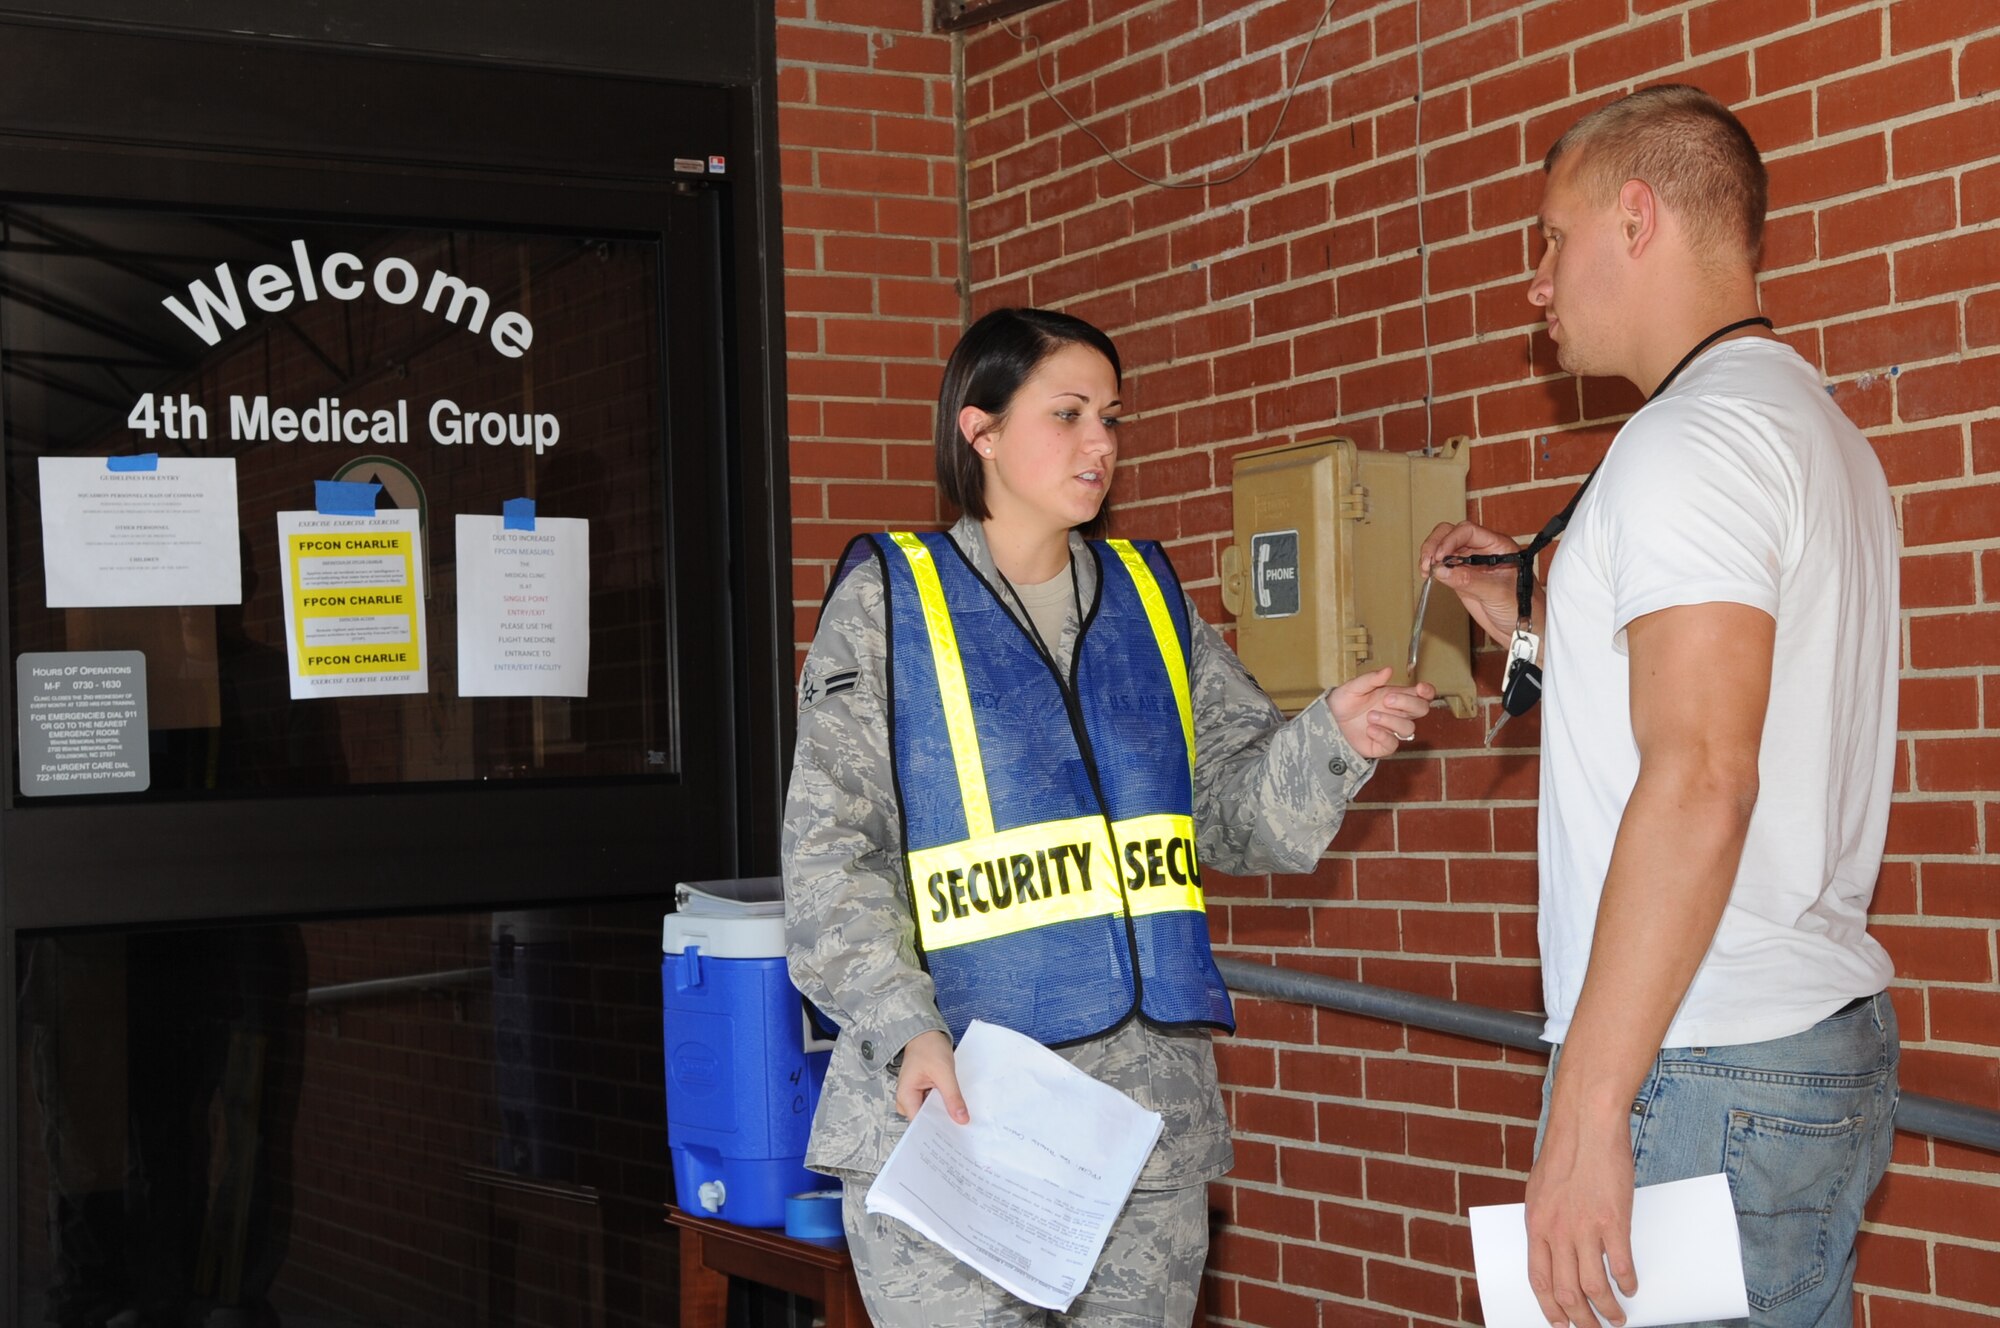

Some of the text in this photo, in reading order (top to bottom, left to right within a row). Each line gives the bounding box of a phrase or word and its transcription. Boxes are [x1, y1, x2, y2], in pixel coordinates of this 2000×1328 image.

[161, 239, 534, 358] Welcome
[127, 393, 560, 455] 4th Medical Group
[299, 539, 399, 551] FPCON CHARLIE
[519, 548, 555, 556] MEASURES
[1265, 567, 1295, 581] PHONE
[304, 595, 403, 607] FPCON CHARLIE
[503, 595, 526, 603] SINGLE
[500, 622, 553, 630] PLEASE USE THE
[523, 636, 556, 644] MEDICINE
[308, 653, 407, 666] FPCON CHARLIE
[64, 667, 78, 676] OF
[44, 682, 61, 690] M-F
[73, 681, 94, 689] 0730
[101, 680, 122, 689] 1630
[48, 712, 105, 720] EMERGENCIES
[94, 720, 128, 728] NEAREST
[49, 729, 95, 739] EMERGENCY
[57, 763, 90, 771] URGENT
[92, 762, 113, 770] CARE
[70, 772, 92, 780] AFTER
[93, 771, 111, 779] DUTY
[927, 841, 1093, 923] SECURITY
[789, 1066, 802, 1086] 4
